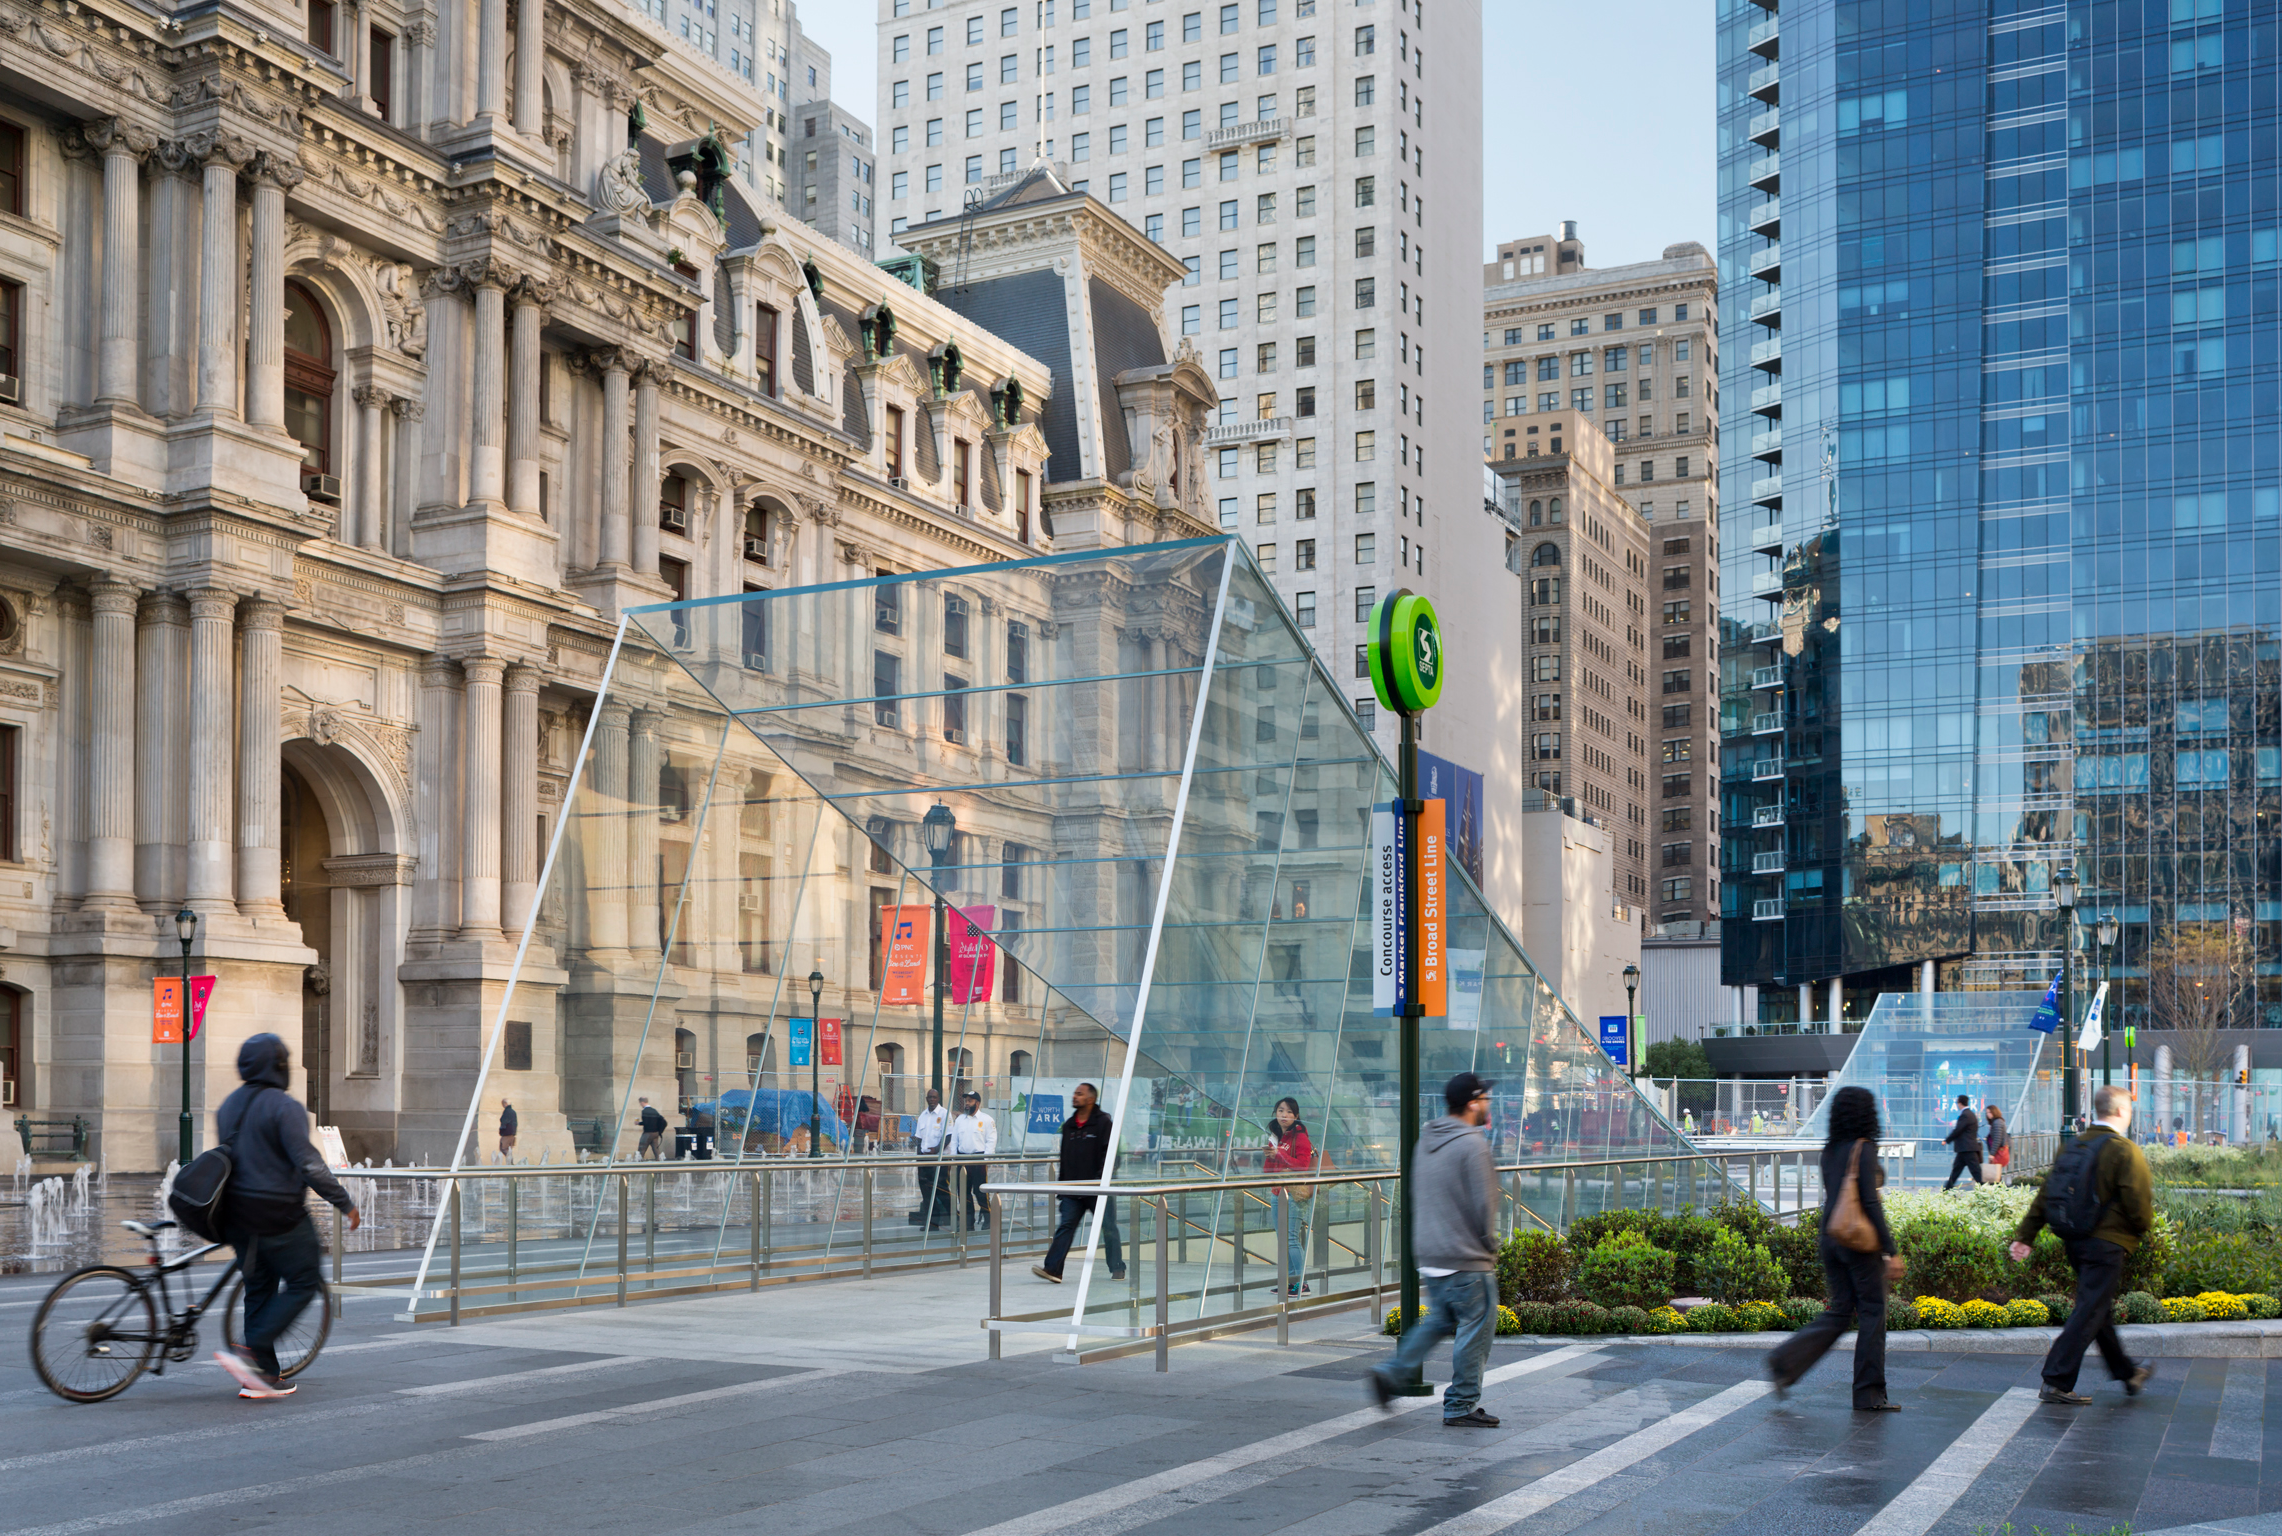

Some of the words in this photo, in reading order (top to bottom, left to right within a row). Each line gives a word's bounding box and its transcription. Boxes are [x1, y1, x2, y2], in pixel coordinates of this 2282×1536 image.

[1419, 660, 1434, 677] SEPTA
[1382, 845, 1392, 894] access
[1423, 835, 1437, 867] Line
[1397, 853, 1405, 926] Frankford
[1424, 871, 1438, 918] Street
[1380, 899, 1392, 976] Concourse
[1424, 922, 1438, 967] Broad
